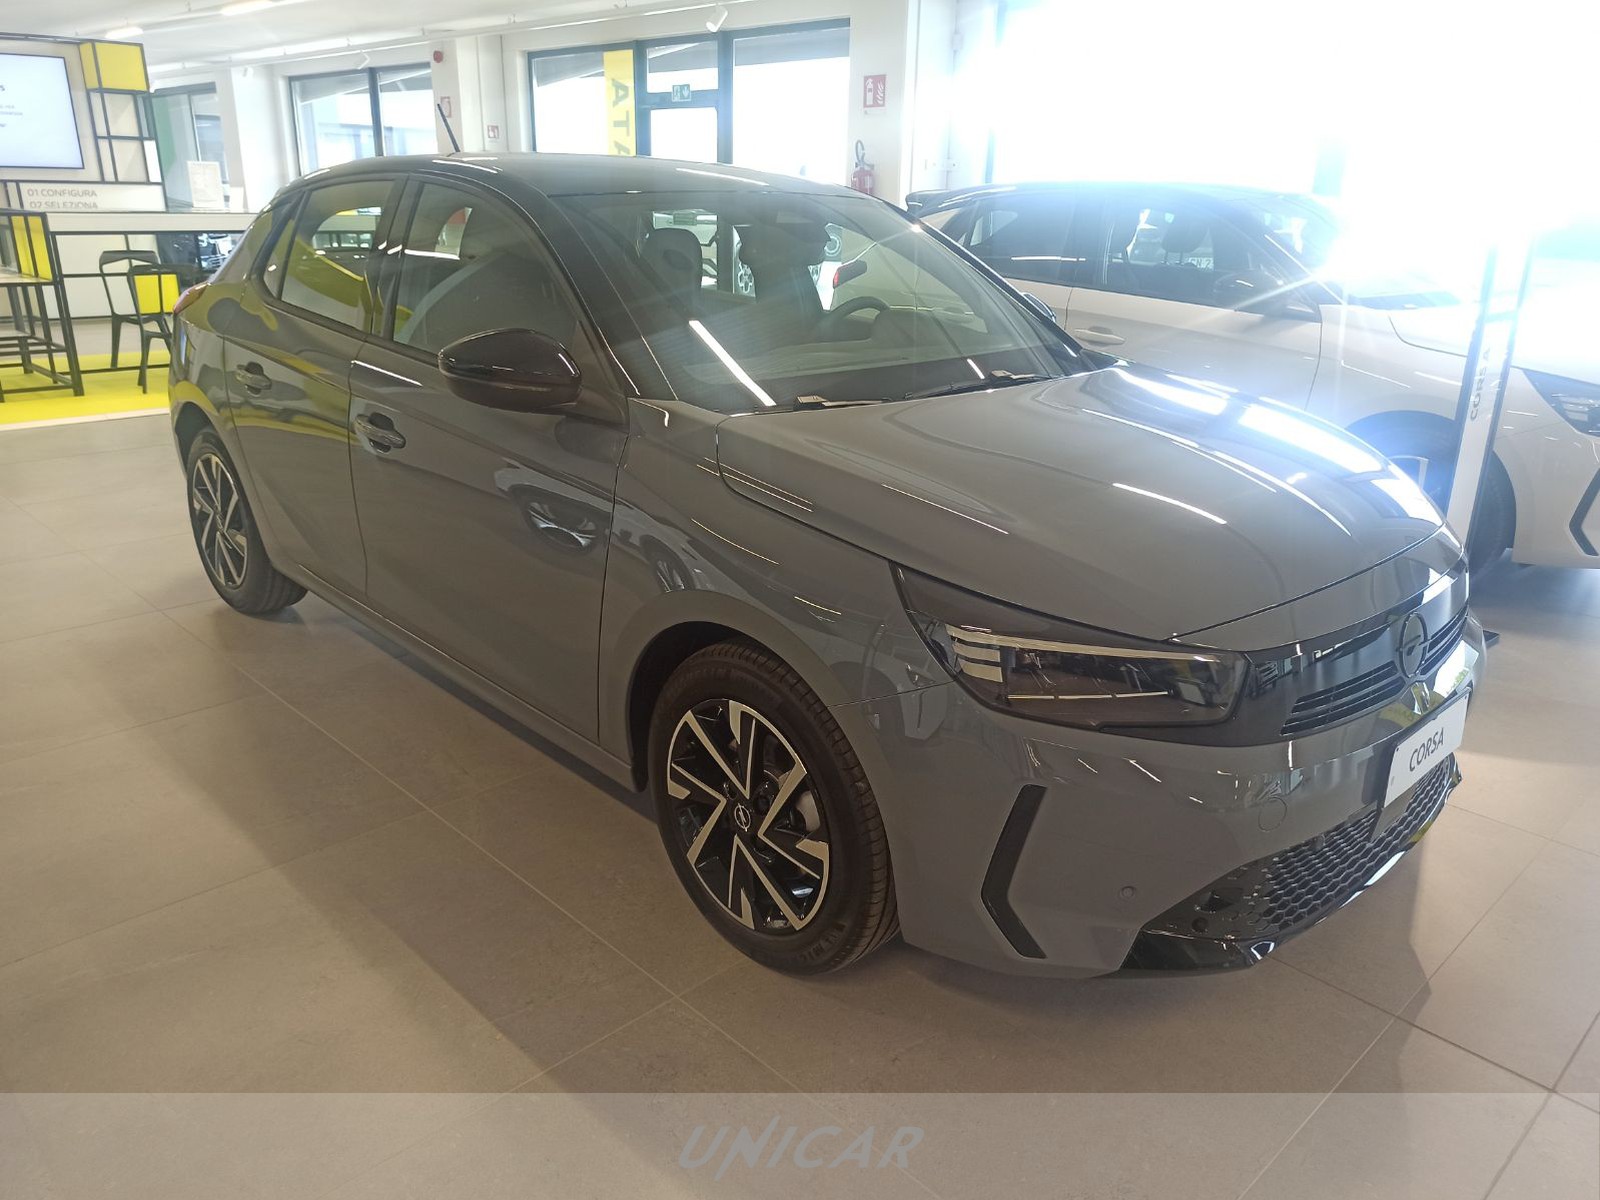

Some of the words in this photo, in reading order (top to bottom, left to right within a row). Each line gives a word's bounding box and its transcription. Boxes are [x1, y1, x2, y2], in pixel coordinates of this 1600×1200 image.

[27, 188, 39, 197] 01
[40, 188, 98, 198] CONFIGURA
[29, 201, 42, 209] 02
[44, 201, 99, 210] SELEZIONA
[1470, 346, 1490, 421] CORSA
[1408, 727, 1444, 772] CORSA
